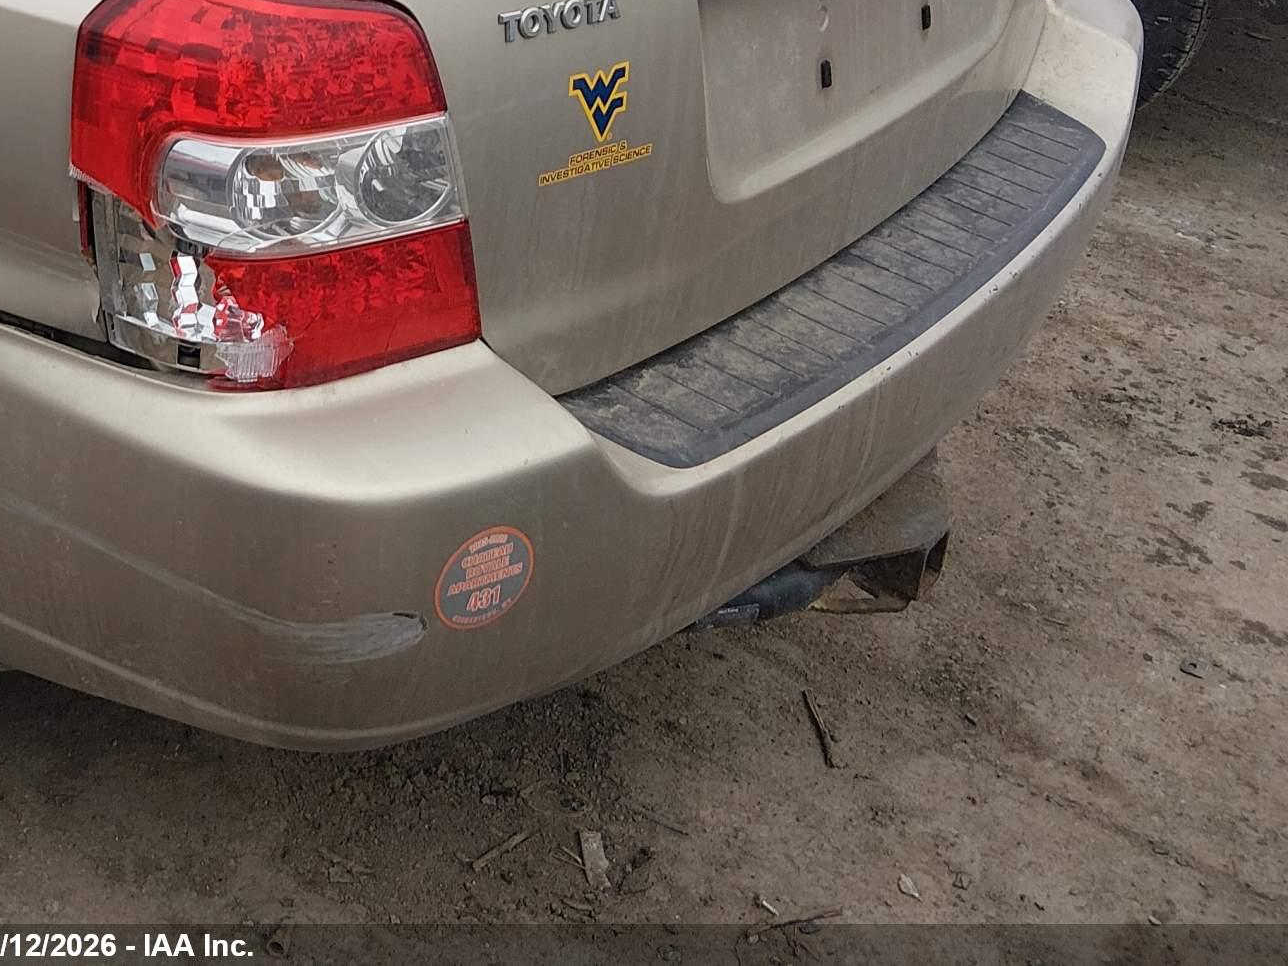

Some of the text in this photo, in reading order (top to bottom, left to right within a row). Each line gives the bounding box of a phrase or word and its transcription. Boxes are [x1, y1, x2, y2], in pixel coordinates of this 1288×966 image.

[539, 144, 651, 185] INVESTIGATIVE SCIENCE
[569, 144, 617, 165] FORENSIC
[466, 584, 501, 612] 431
